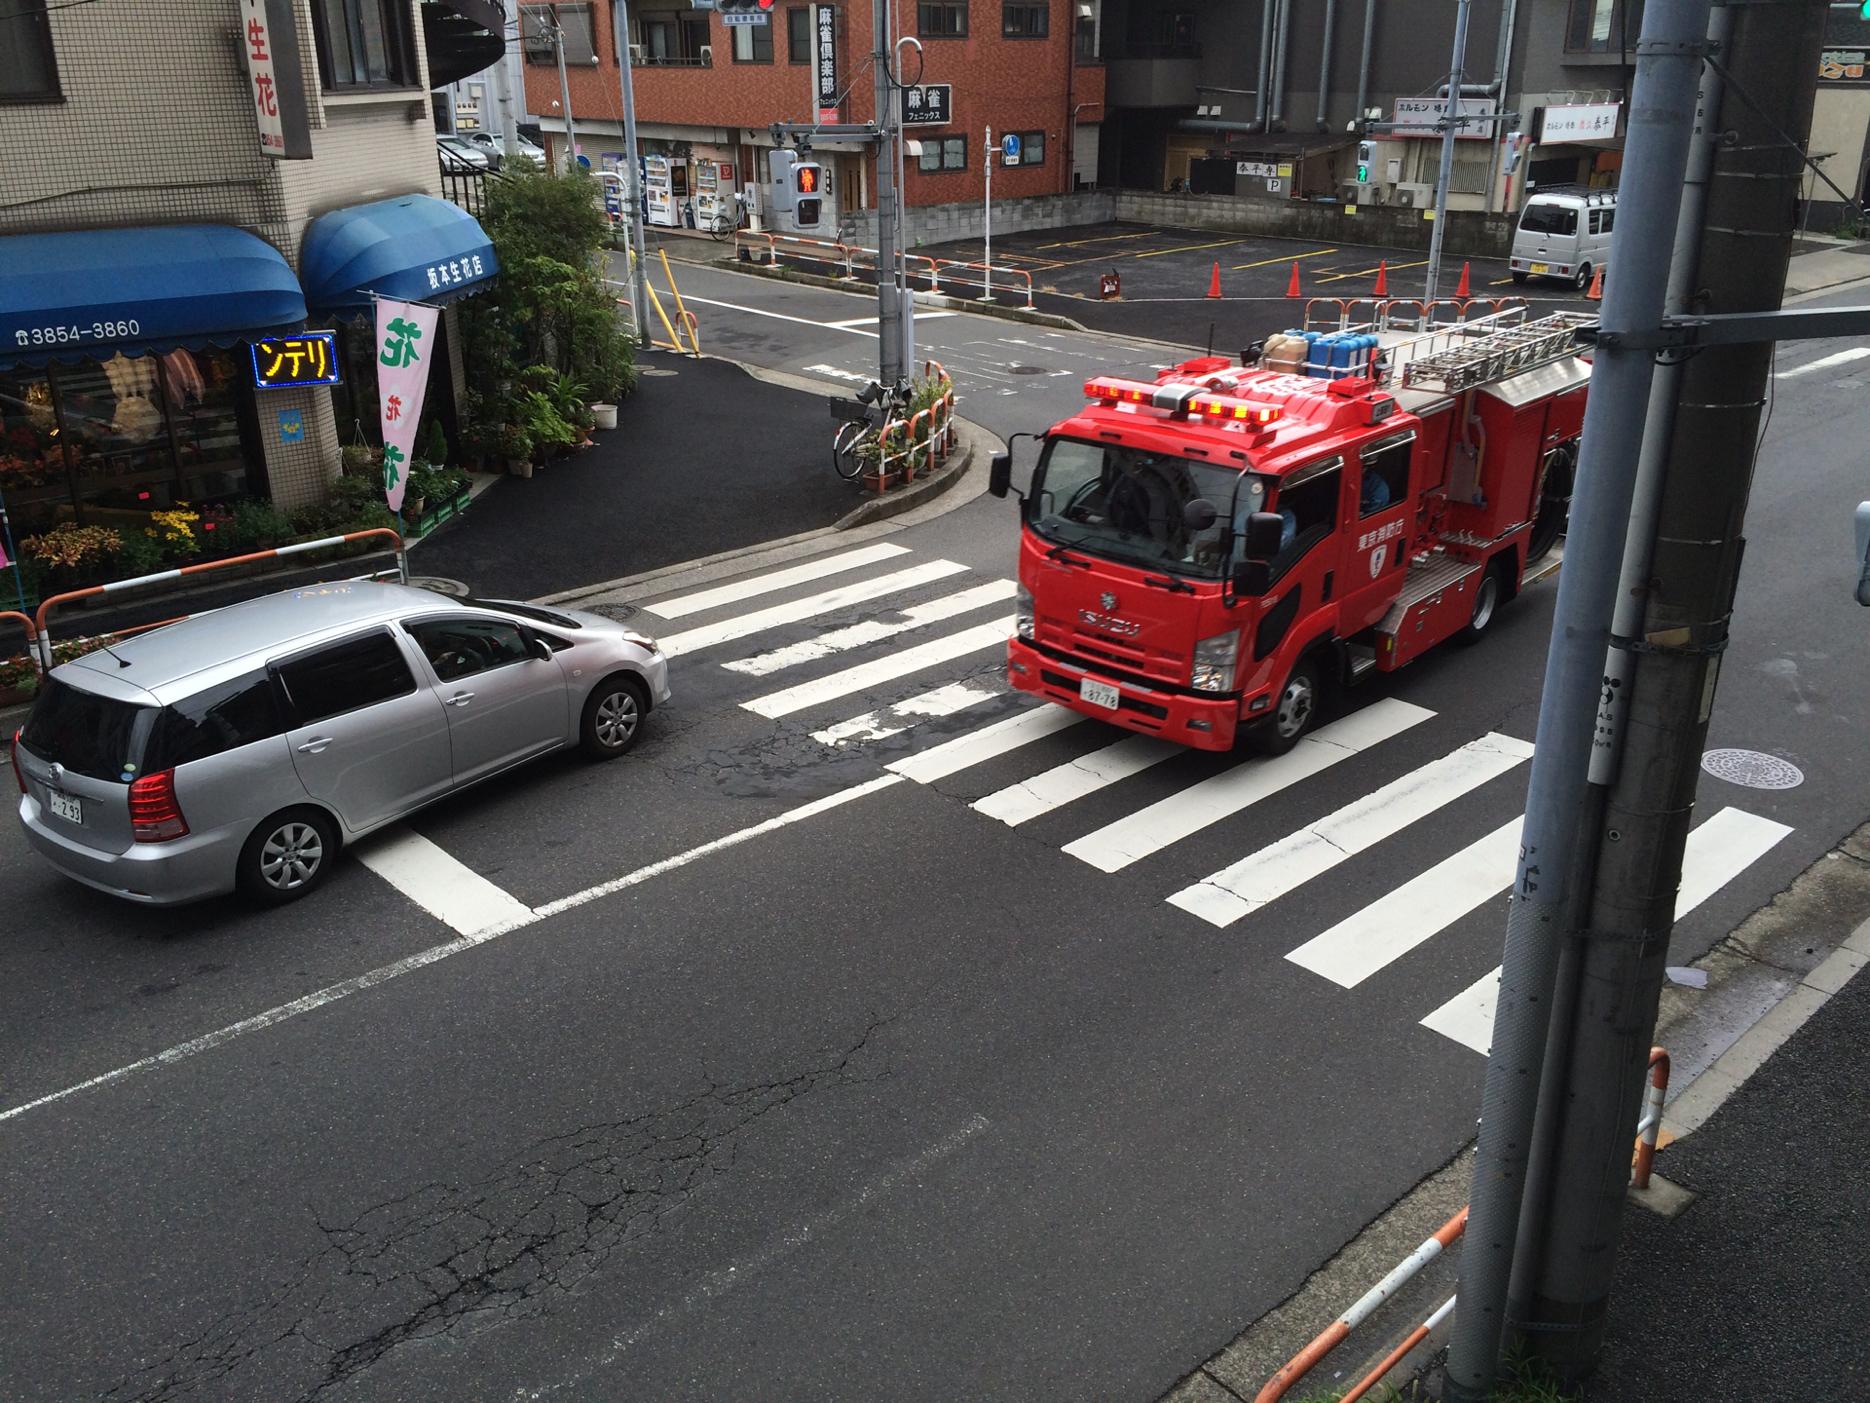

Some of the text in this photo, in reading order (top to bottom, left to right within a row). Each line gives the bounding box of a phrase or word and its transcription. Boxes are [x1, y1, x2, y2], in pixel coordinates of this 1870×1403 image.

[247, 17, 277, 117] 生花
[907, 89, 941, 109] 麻雀
[908, 110, 941, 121] フェニックス
[1270, 179, 1279, 190] P
[31, 319, 140, 345] 3854-3860
[1078, 608, 1141, 637] ISUZU
